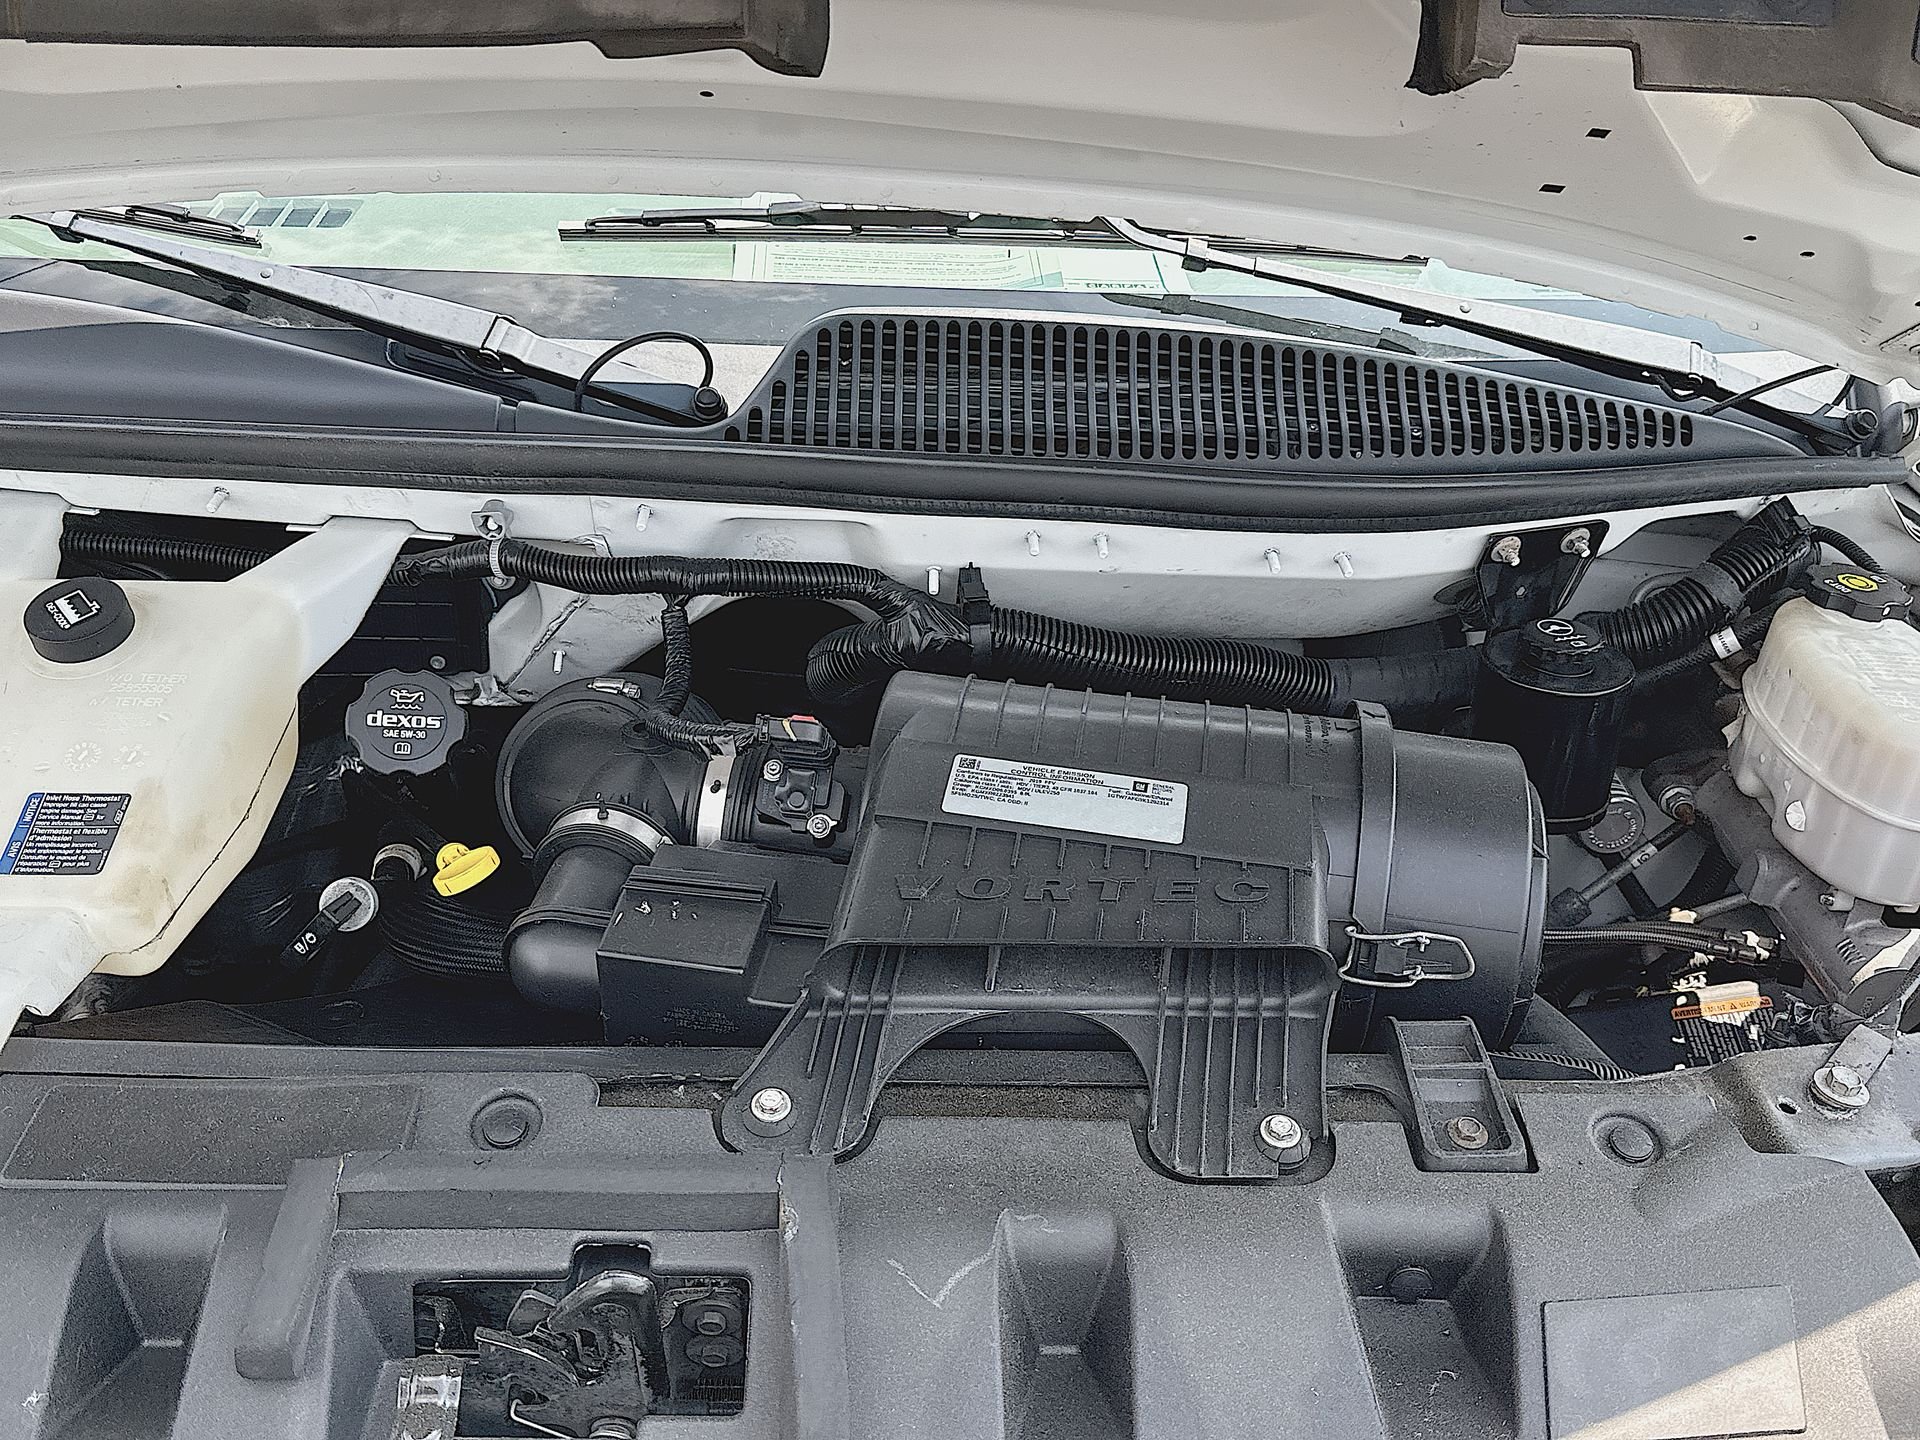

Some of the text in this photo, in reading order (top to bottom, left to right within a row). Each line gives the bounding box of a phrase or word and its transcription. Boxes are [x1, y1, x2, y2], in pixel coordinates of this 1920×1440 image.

[140, 672, 188, 684] TETHER
[367, 710, 443, 728] dexos
[383, 729, 426, 739] SAE 5W-30
[1010, 769, 1104, 784] CONTROL INFORMATION
[1057, 770, 1095, 779] EMISSION
[23, 797, 40, 822] NOTICE
[8, 841, 21, 858] AVIS
[895, 874, 1270, 902] VORTEC
